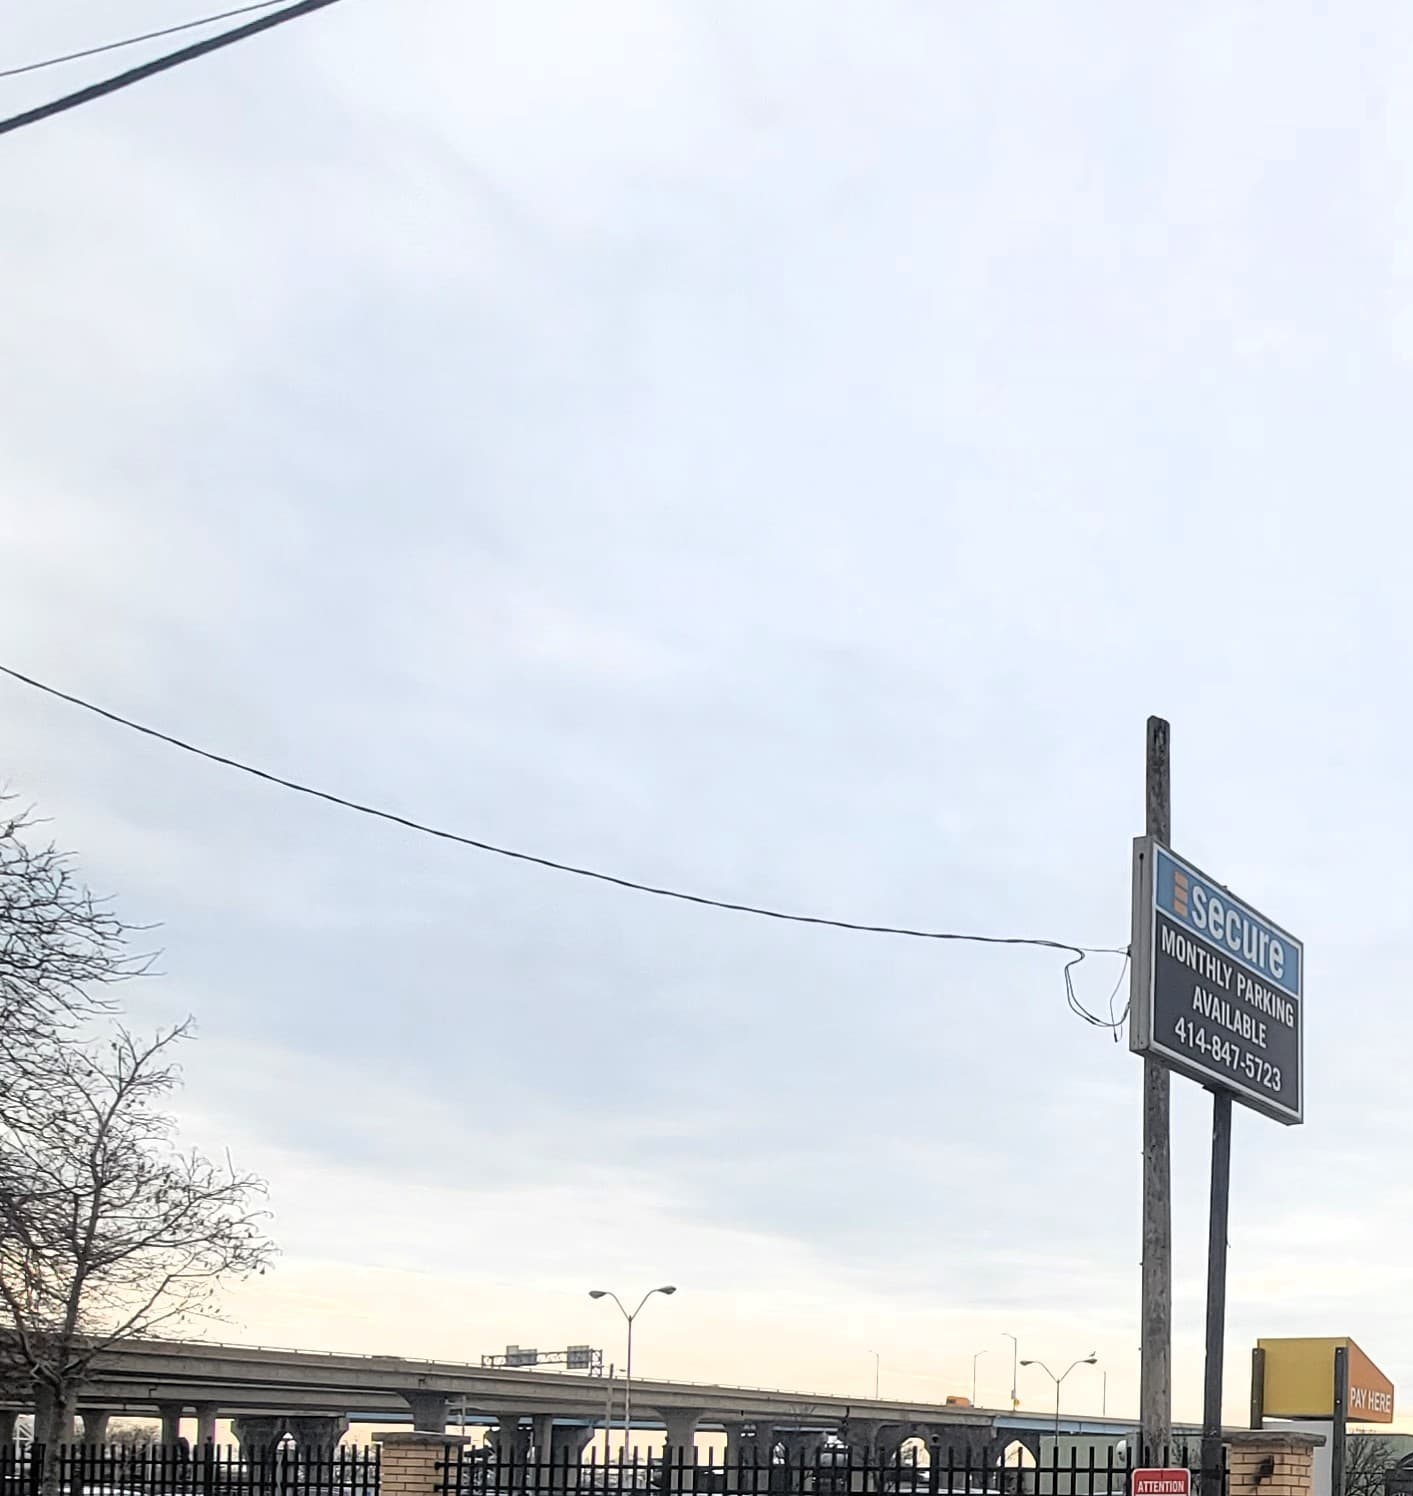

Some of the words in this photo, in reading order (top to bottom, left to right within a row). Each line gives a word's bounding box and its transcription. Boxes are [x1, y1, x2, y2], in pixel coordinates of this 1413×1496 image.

[1191, 886, 1285, 979] secure
[1161, 925, 1233, 990] MONTHLY
[1236, 972, 1294, 1028] PARKING
[1192, 985, 1267, 1049] AVAILABLE
[1174, 1016, 1282, 1092] 414-847-5723
[1350, 1386, 1367, 1409] PAY
[1367, 1389, 1391, 1414] HERE
[1137, 1480, 1185, 1493] ATTENTION
